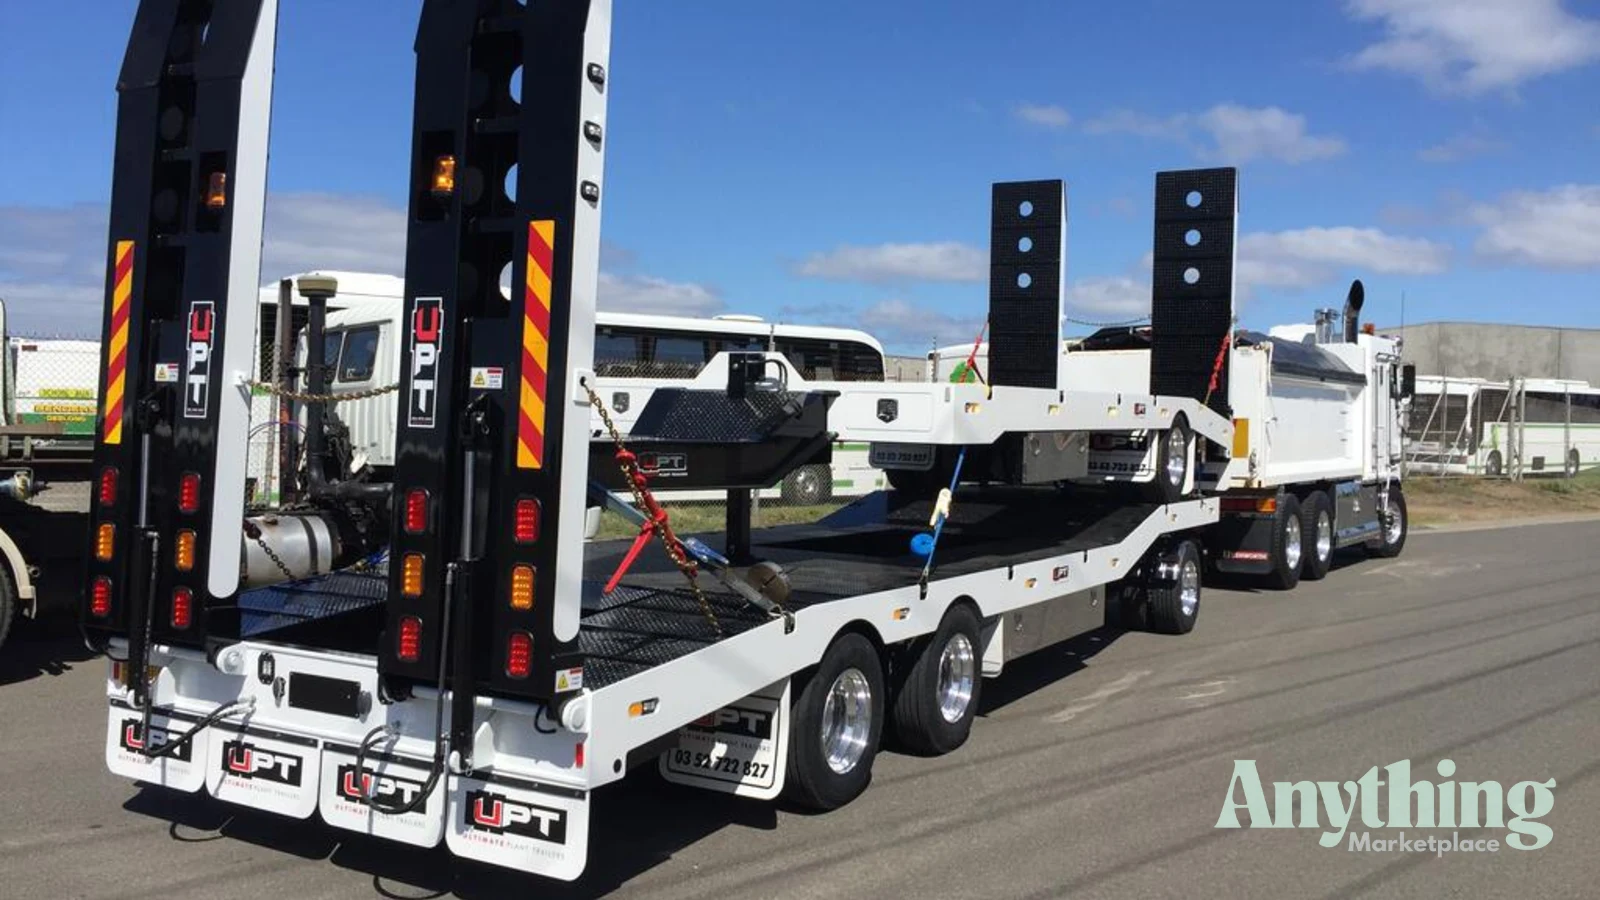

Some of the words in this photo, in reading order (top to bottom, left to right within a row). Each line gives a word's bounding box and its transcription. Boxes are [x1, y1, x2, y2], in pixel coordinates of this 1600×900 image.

[190, 309, 212, 405] UPT
[414, 306, 440, 413] UPT
[228, 747, 298, 781] UPT
[674, 749, 691, 766] 03
[693, 752, 710, 770] 52
[713, 757, 740, 775] 722
[742, 760, 769, 779] 827
[343, 771, 422, 804] UPT
[473, 797, 561, 837] UPT
